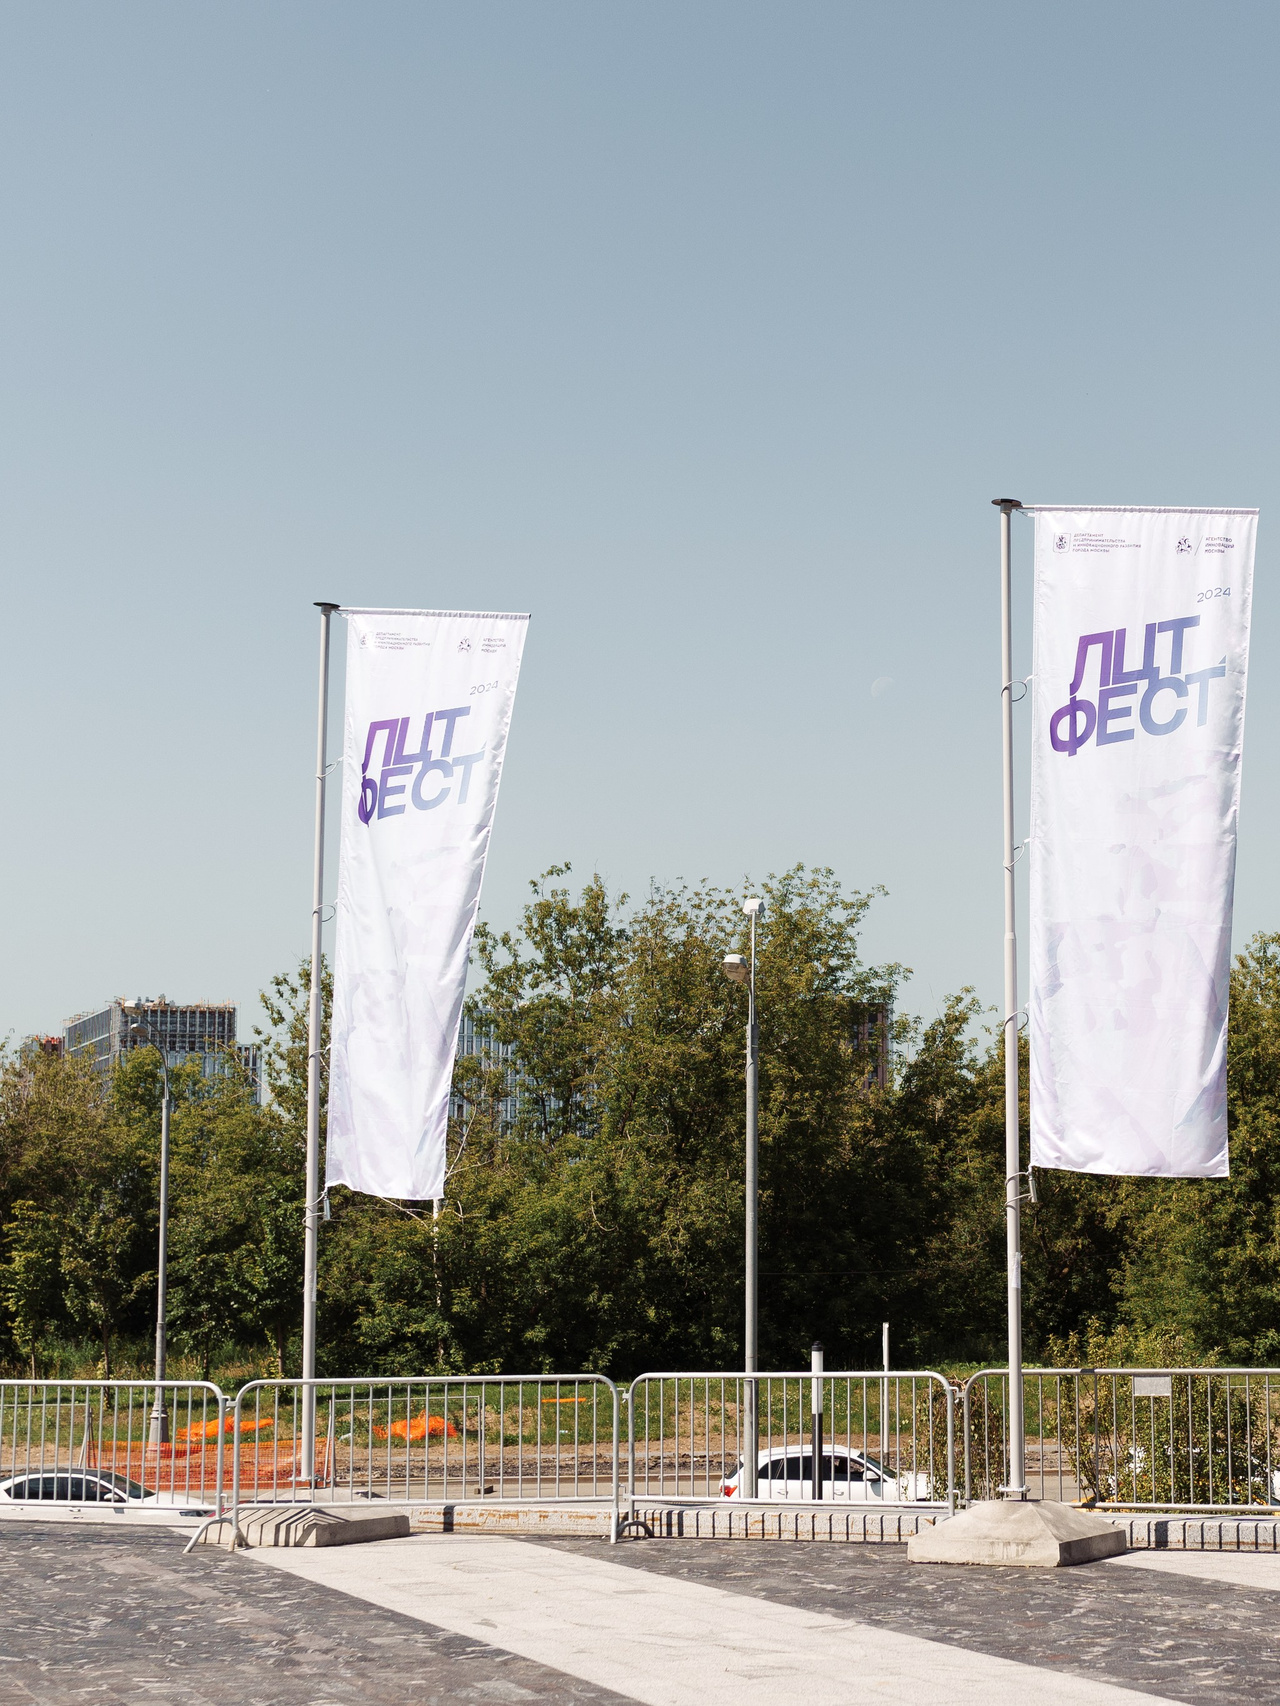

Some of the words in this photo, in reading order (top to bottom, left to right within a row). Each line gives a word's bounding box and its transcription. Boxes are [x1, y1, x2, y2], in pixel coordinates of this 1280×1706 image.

[1197, 586, 1232, 604] 2024
[469, 680, 499, 696] 2024
[1069, 614, 1201, 697] ЛЦТ
[361, 705, 472, 775] ЛЦТ
[1050, 655, 1227, 758] ФЕСТ
